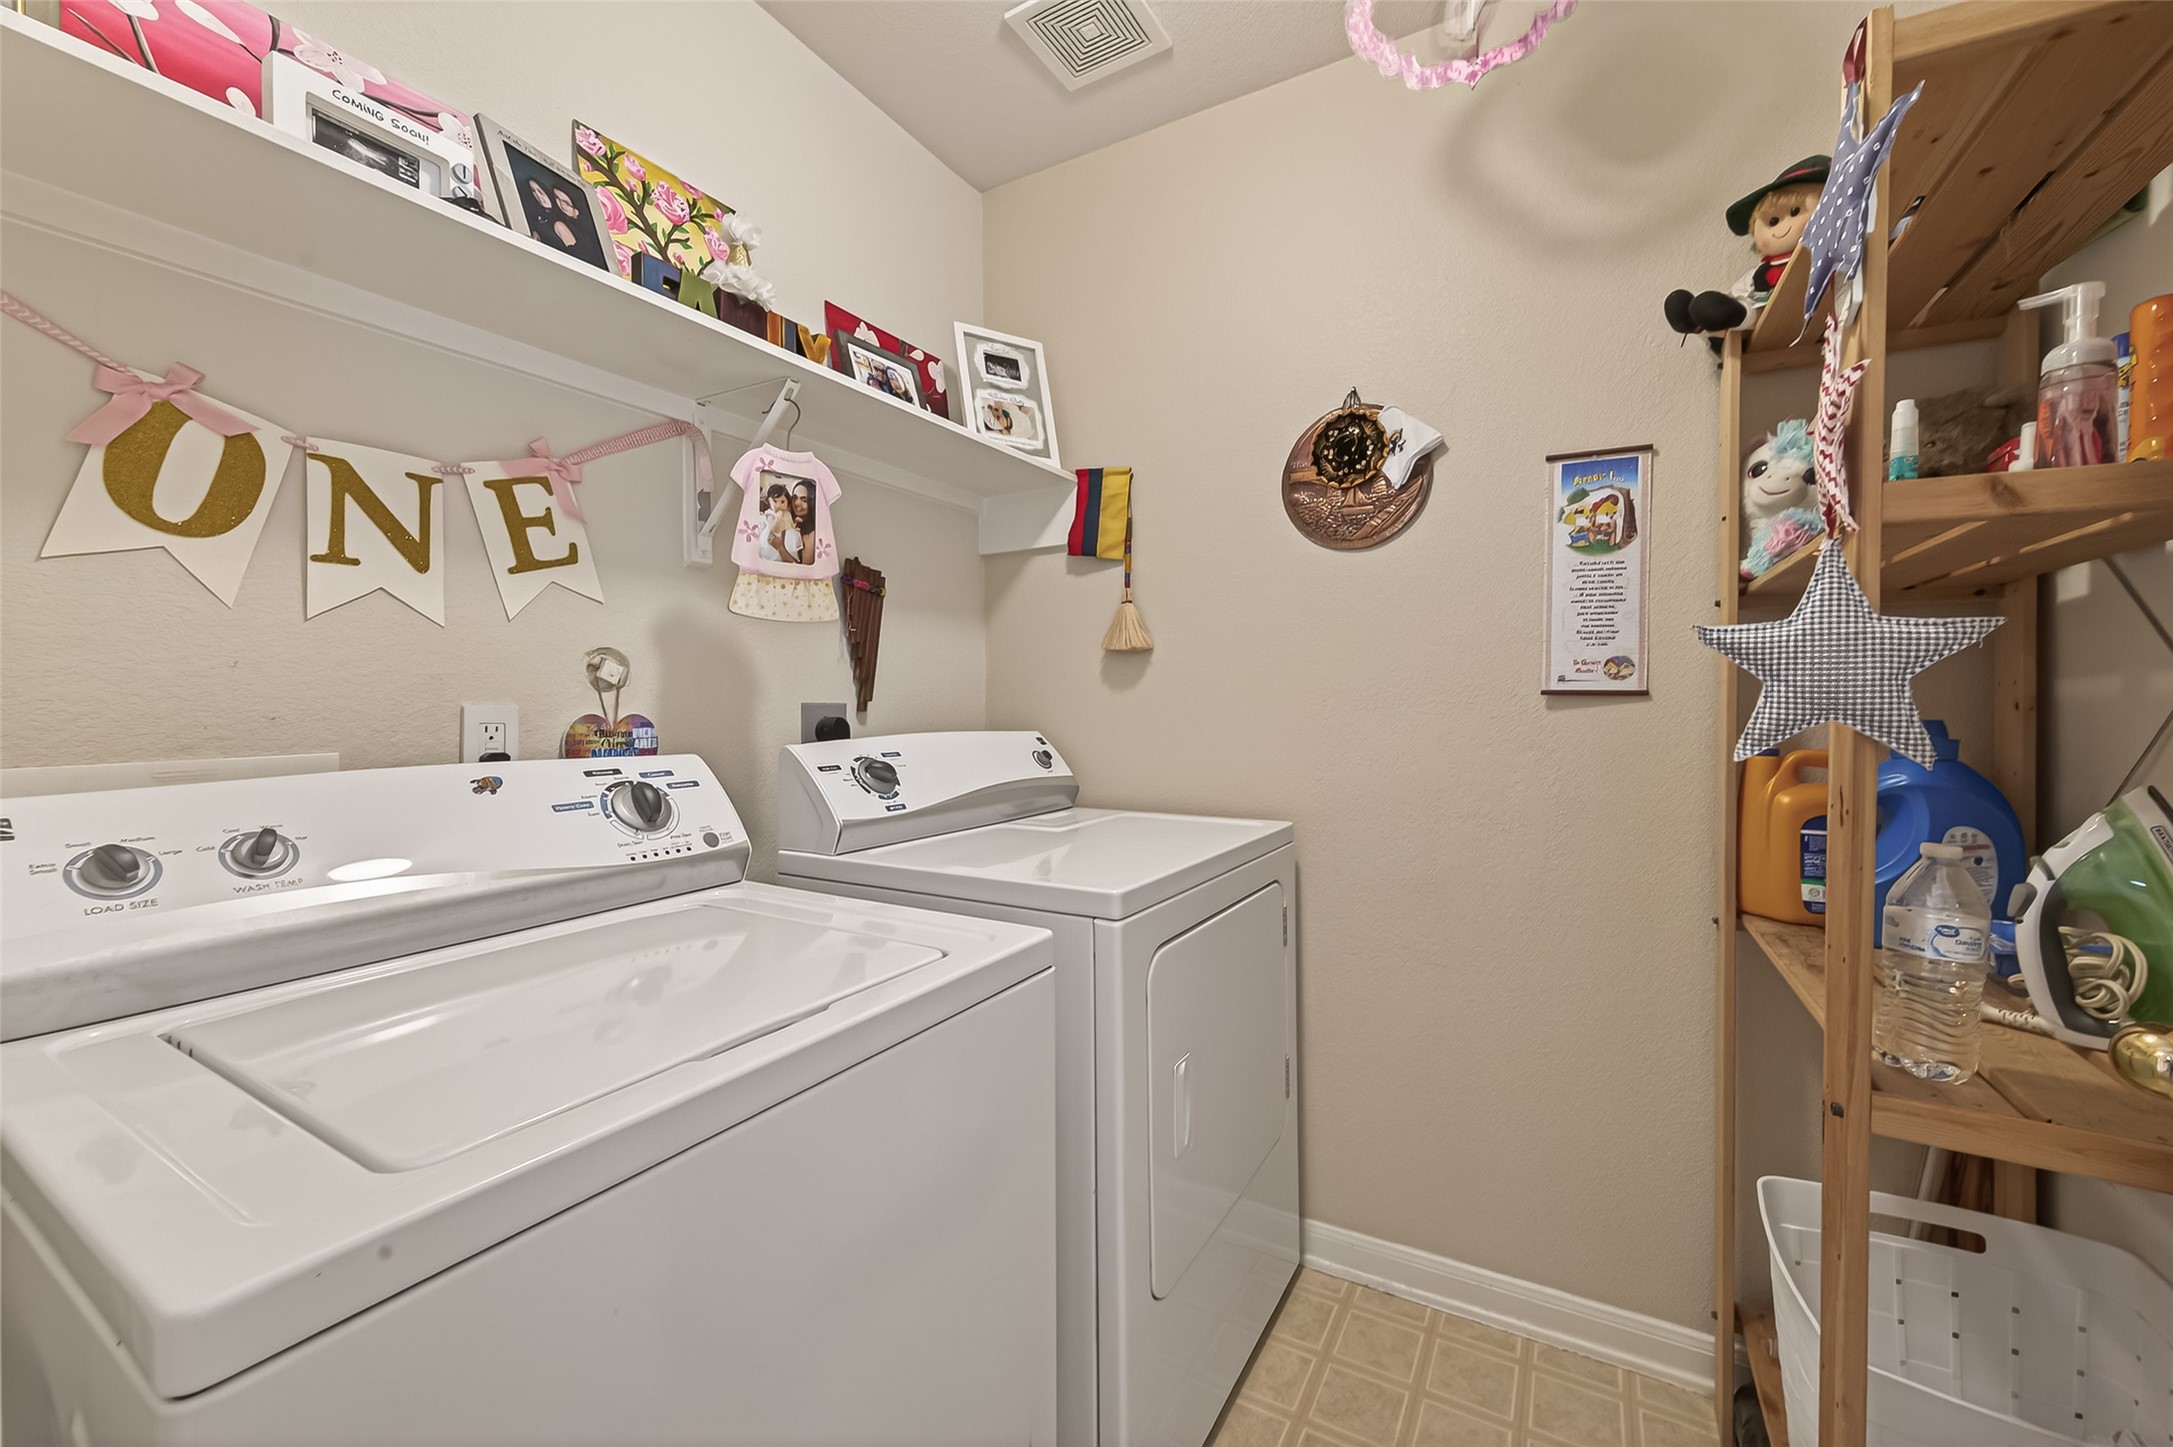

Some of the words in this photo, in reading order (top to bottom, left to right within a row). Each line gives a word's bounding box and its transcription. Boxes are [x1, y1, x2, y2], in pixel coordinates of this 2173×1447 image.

[331, 88, 385, 122] COMING
[102, 400, 579, 575] ONE
[233, 882, 271, 894] WASH
[274, 877, 304, 889] TEMP
[83, 903, 125, 916] LOAD
[128, 898, 159, 911] SIZE
